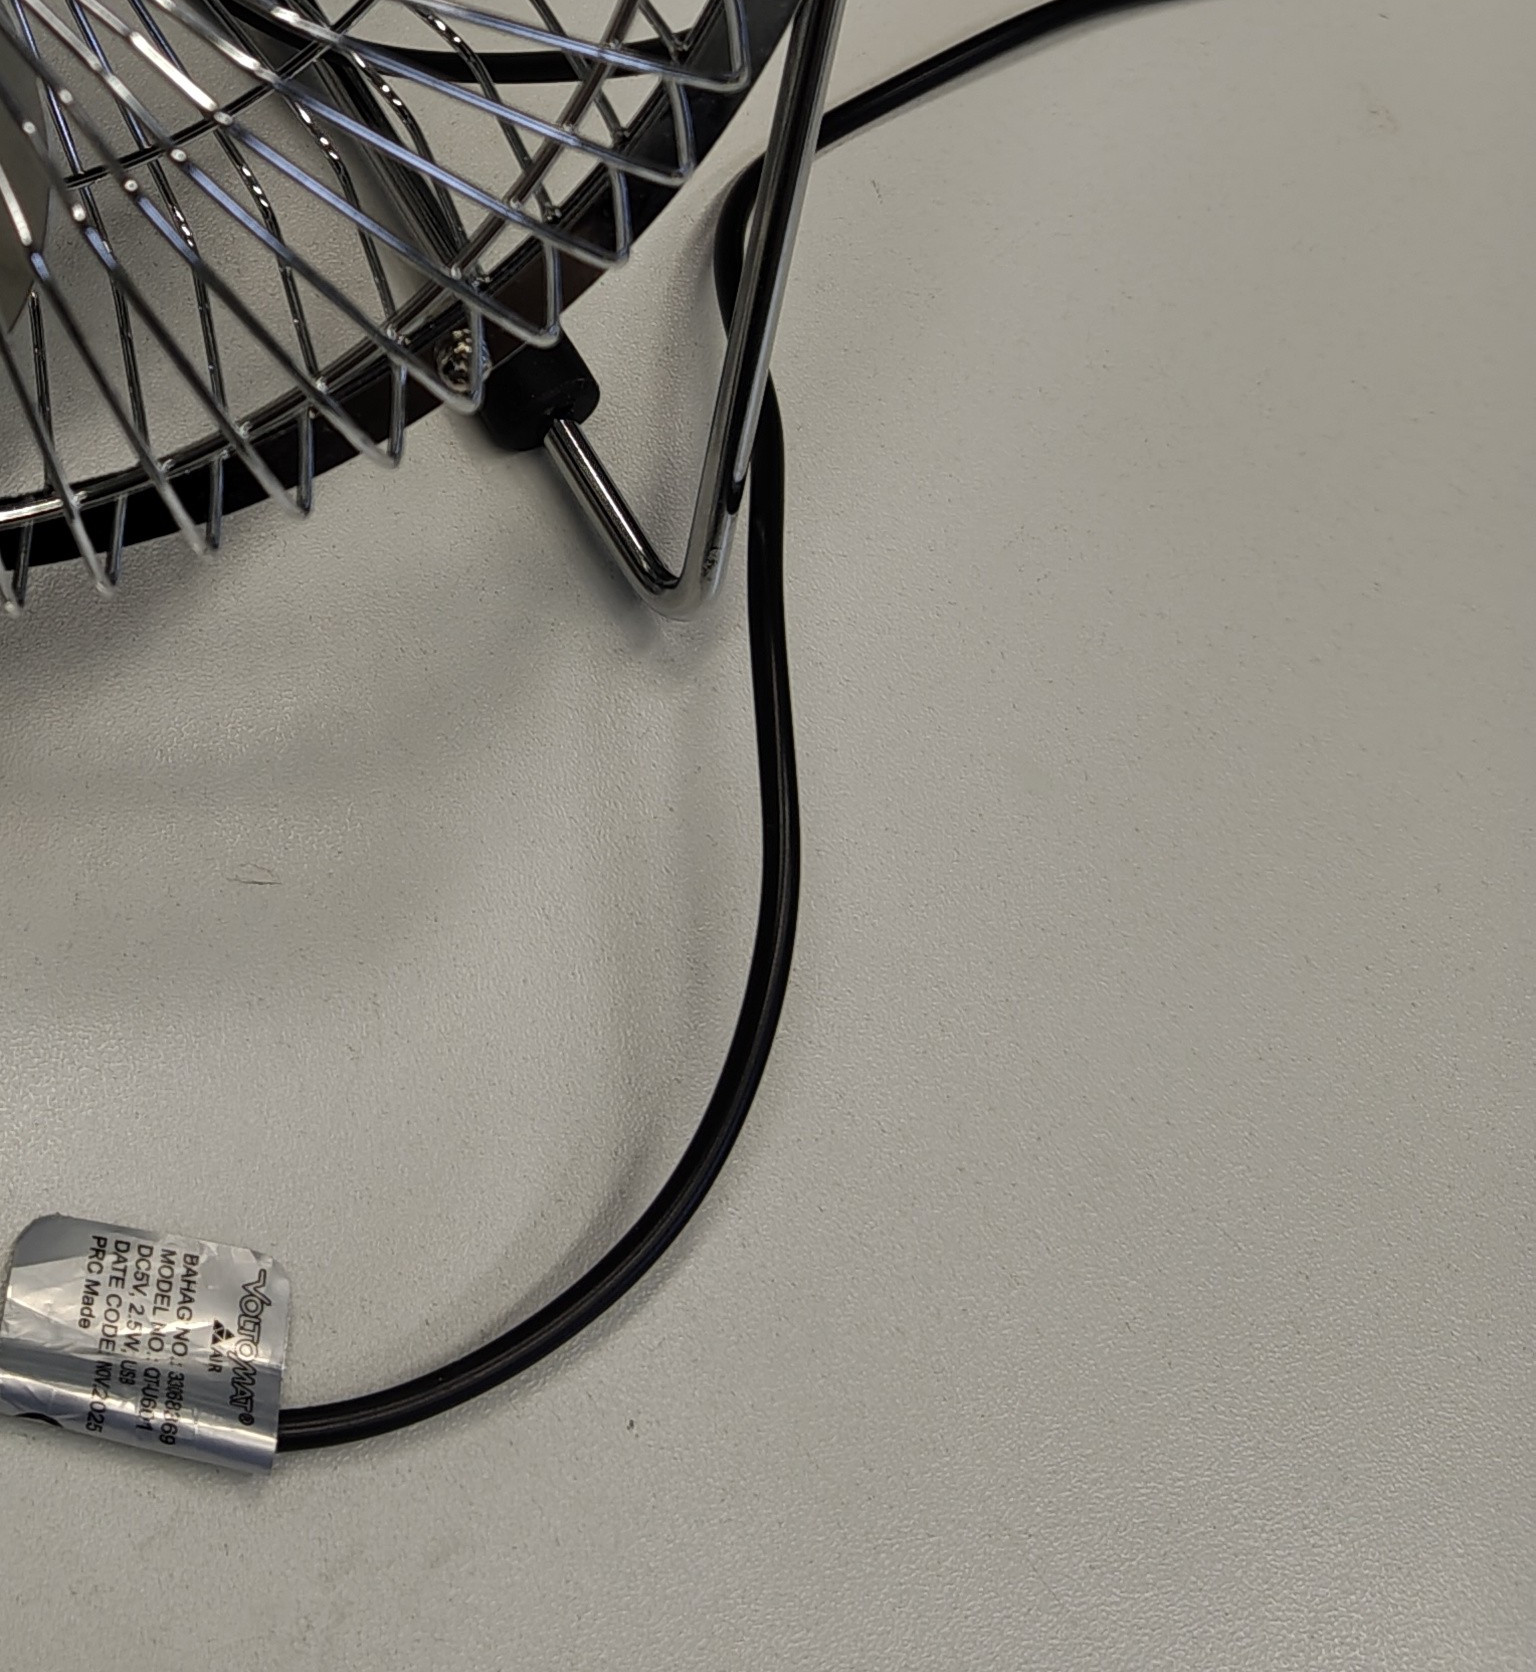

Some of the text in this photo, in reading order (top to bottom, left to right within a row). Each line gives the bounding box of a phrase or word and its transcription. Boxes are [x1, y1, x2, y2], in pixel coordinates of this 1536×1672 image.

[77, 1235, 108, 1329] PRC Made
[108, 1239, 131, 1290] DATE
[152, 1248, 177, 1317] MODEL
[176, 1253, 199, 1322] BAHAG
[118, 1243, 154, 1386] DC5V, 2.5W, USB
[208, 1346, 222, 1374] AIR
